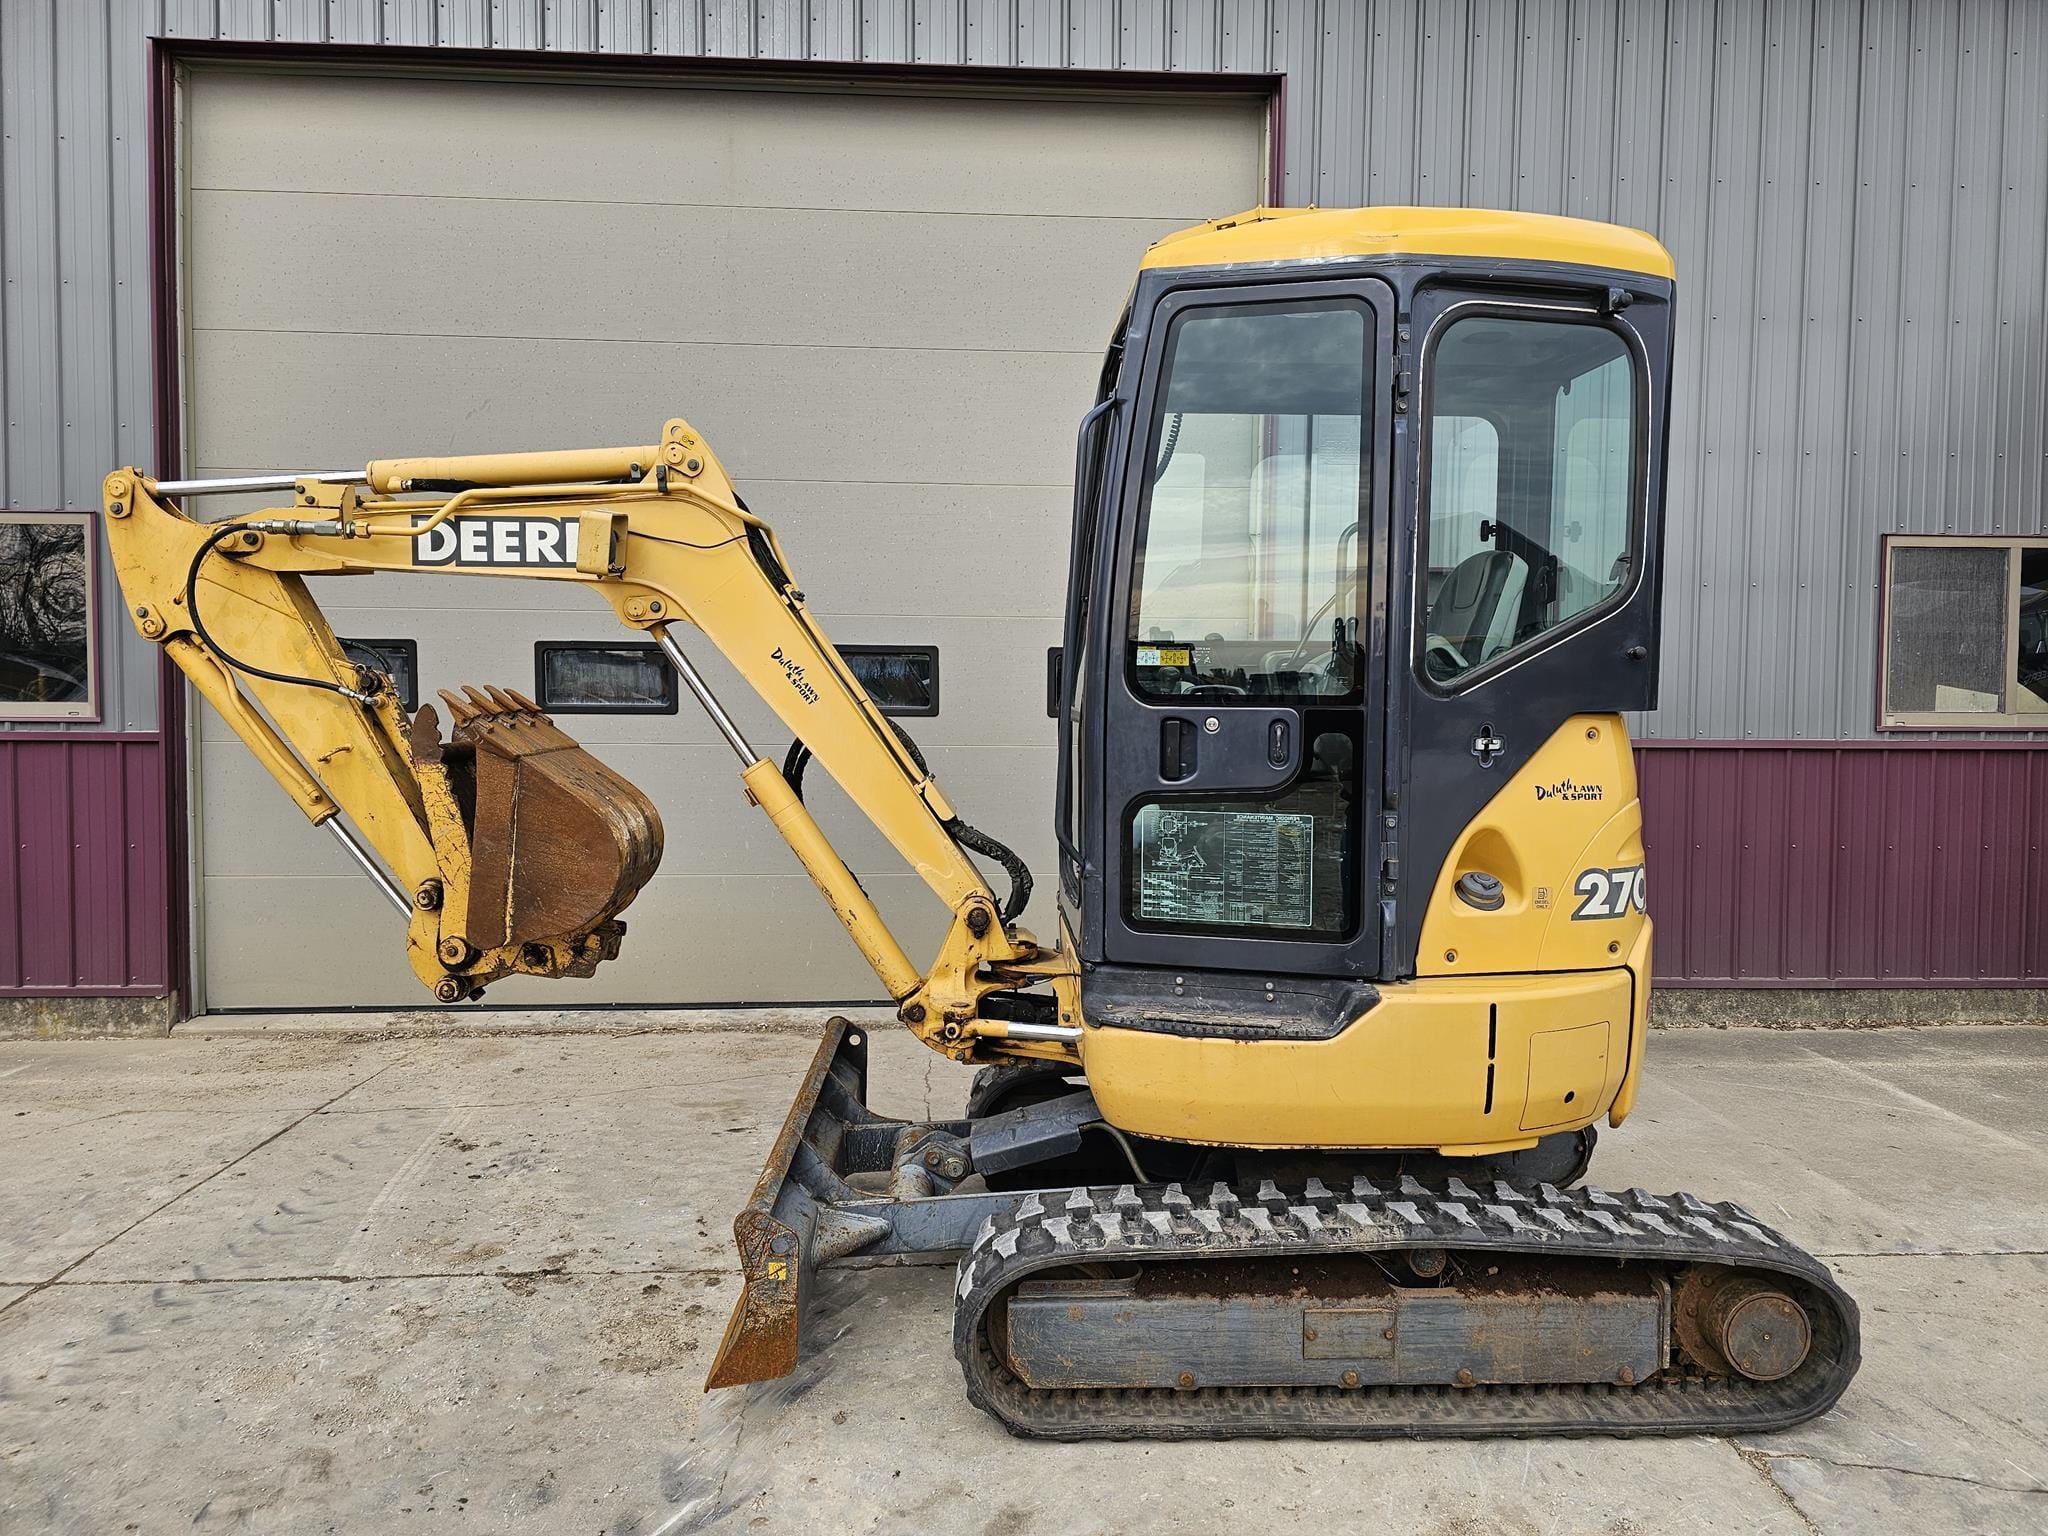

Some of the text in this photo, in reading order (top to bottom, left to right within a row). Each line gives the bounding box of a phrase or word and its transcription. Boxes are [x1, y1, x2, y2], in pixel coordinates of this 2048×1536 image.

[770, 646, 820, 702] Duluth LAWN
[785, 672, 816, 705] & SPORT
[1534, 777, 1603, 801] Duluth LAWN
[1562, 793, 1603, 801] & SPORT
